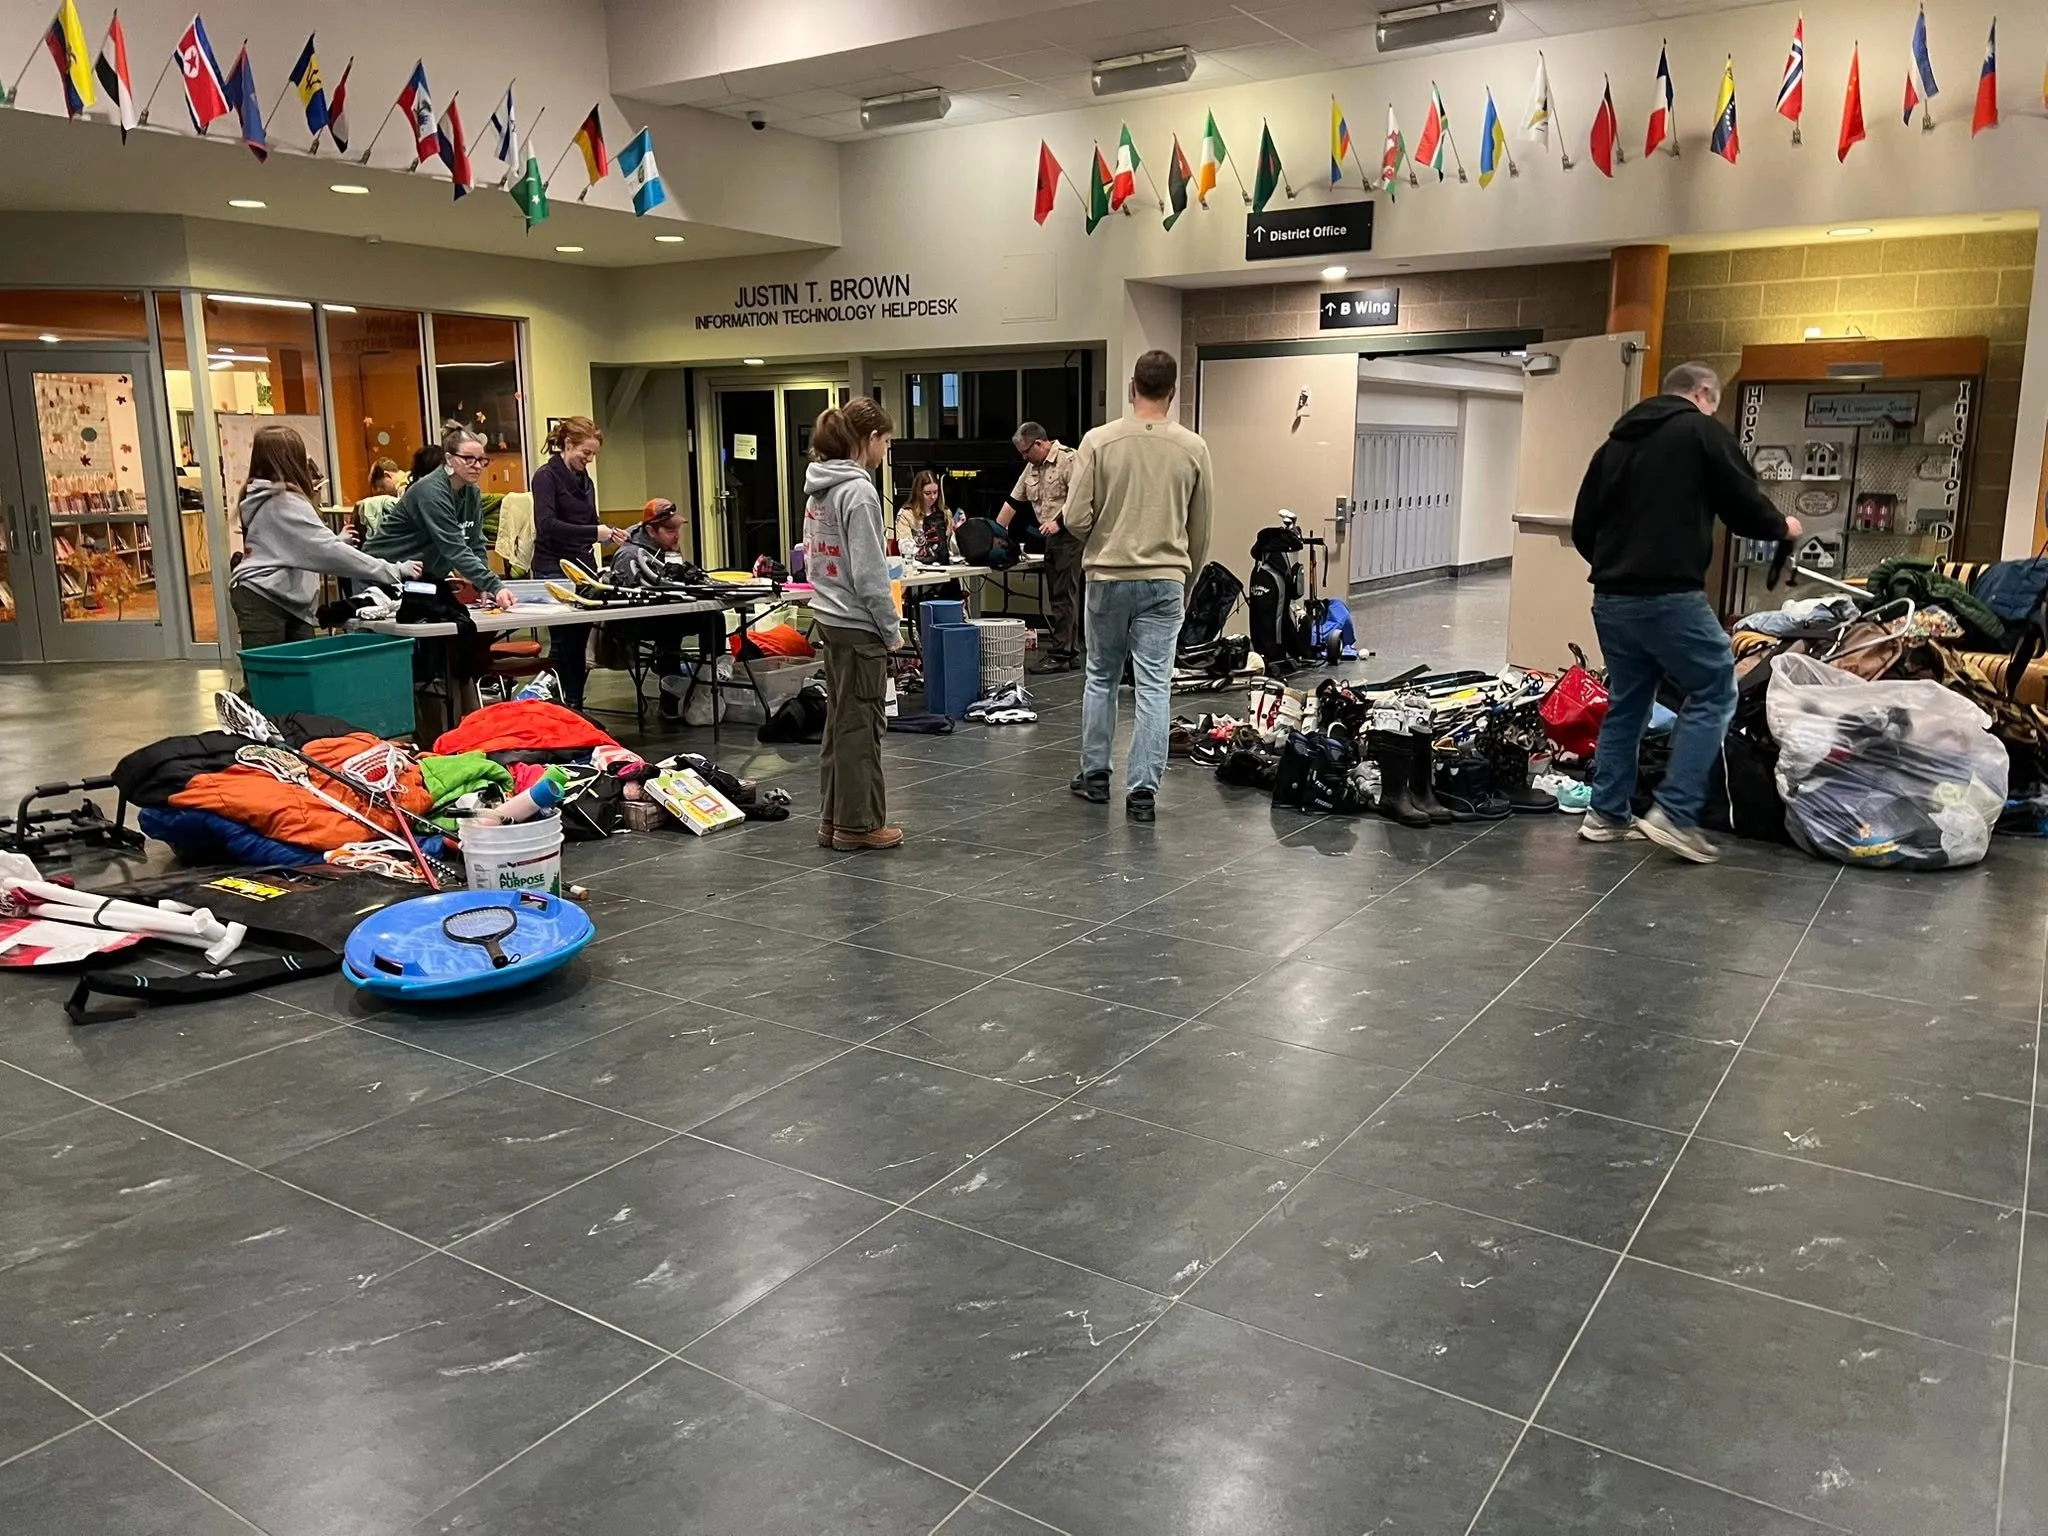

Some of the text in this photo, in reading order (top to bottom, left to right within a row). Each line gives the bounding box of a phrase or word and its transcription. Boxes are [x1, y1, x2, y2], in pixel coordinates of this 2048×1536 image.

[1269, 225, 1347, 242] District Office
[734, 274, 910, 308] JUSTIN T. BROWN
[695, 298, 958, 330] INFORMATION TECHNOLOGY HELPDESK
[1340, 300, 1391, 316] B Wing
[499, 871, 518, 881] ALL
[500, 873, 545, 889] PURPOSE
